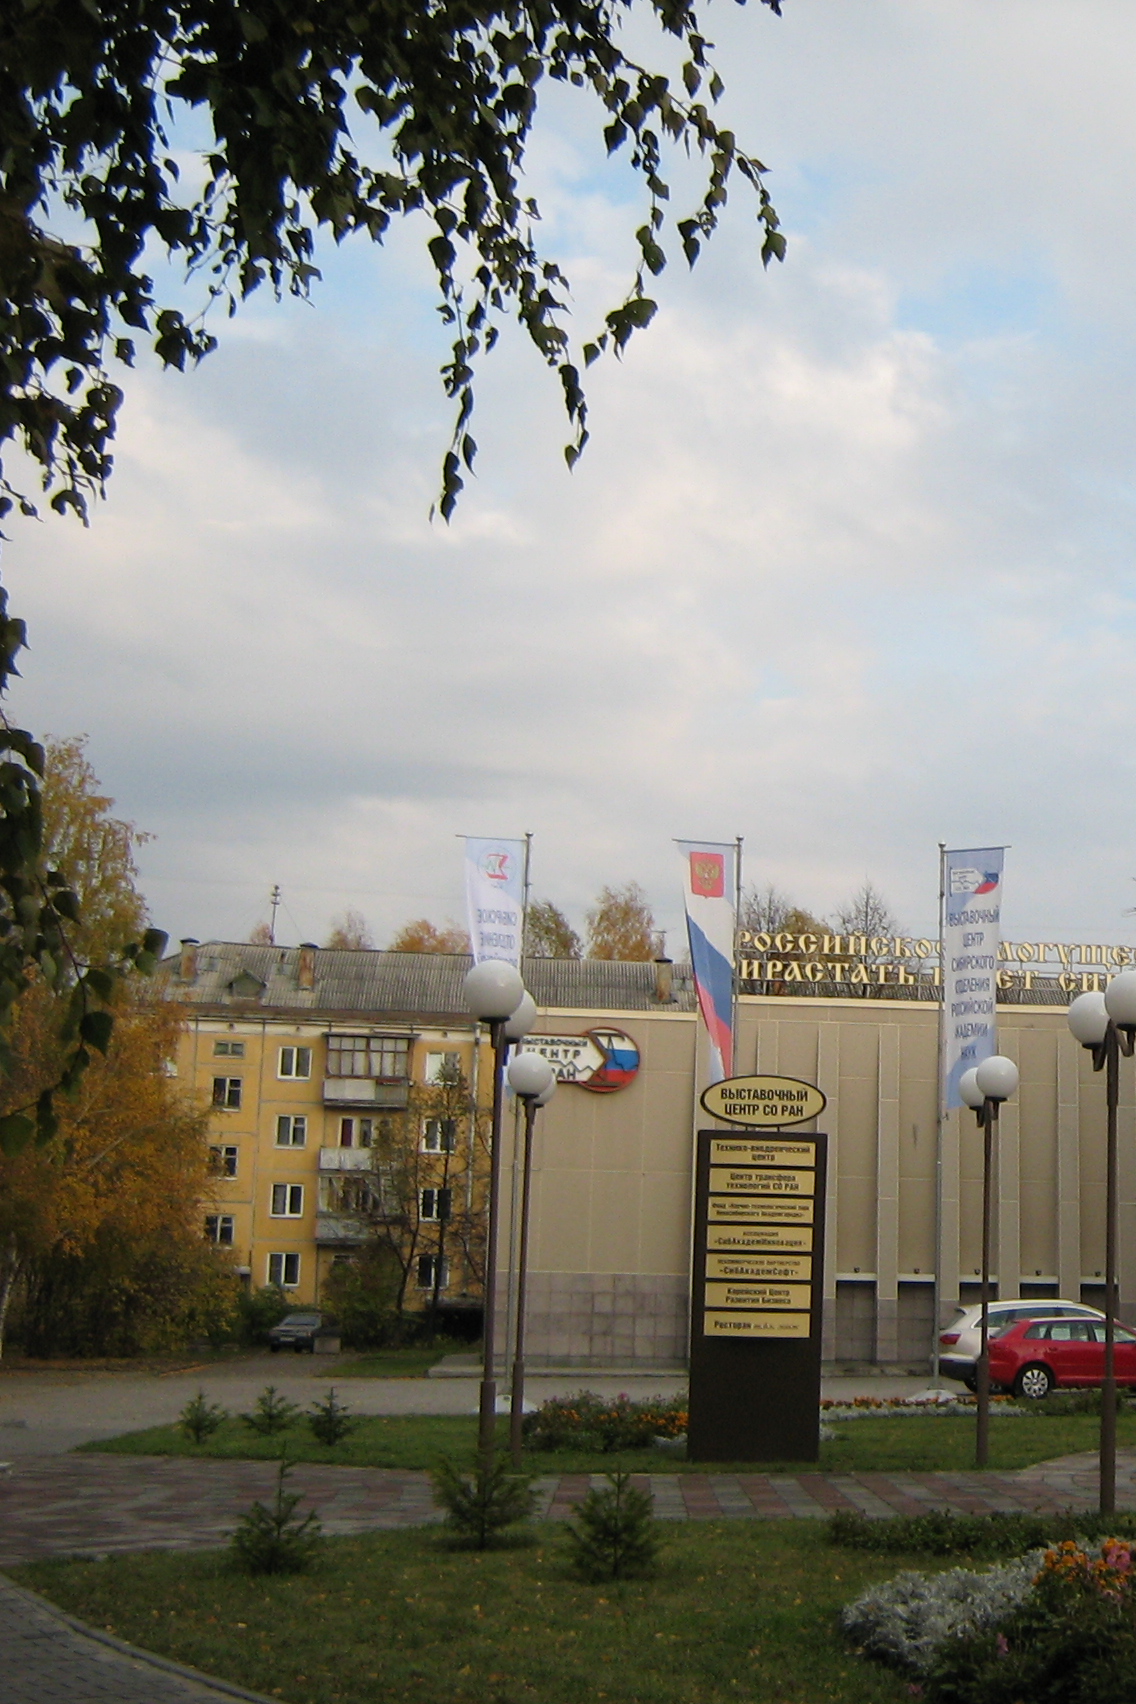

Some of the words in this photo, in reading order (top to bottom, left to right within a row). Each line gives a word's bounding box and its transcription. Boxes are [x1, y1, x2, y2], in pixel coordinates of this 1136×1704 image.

[740, 958, 915, 986] ИРАСТАТЬ
[720, 1087, 808, 1102] ВЫСТАВОЧНЫЙ
[724, 1104, 759, 1116] ЦЕНТР
[763, 1105, 778, 1116] СО
[781, 1105, 804, 1117] РАН
